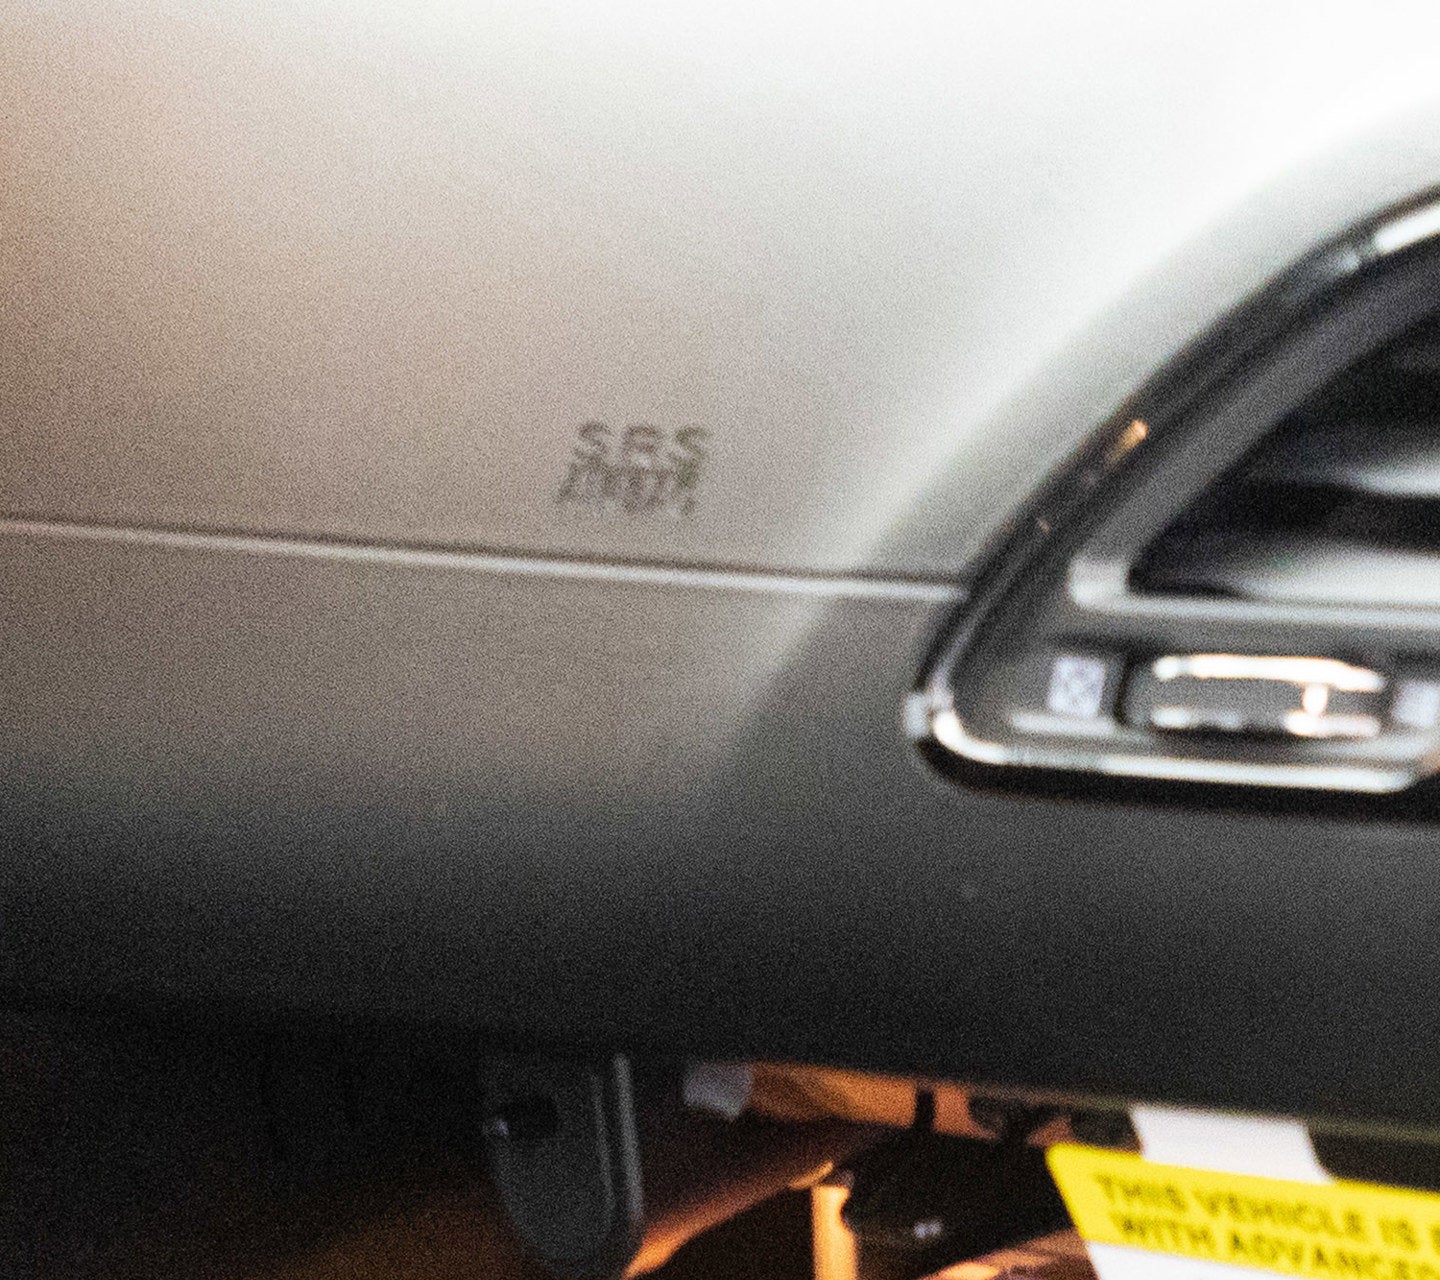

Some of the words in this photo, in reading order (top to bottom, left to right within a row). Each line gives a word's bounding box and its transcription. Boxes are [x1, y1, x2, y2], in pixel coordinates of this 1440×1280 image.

[1093, 1172, 1185, 1215] THIS
[1200, 1185, 1366, 1239] VEHICLE
[1379, 1216, 1419, 1252] IS
[1114, 1216, 1218, 1260] WITH
